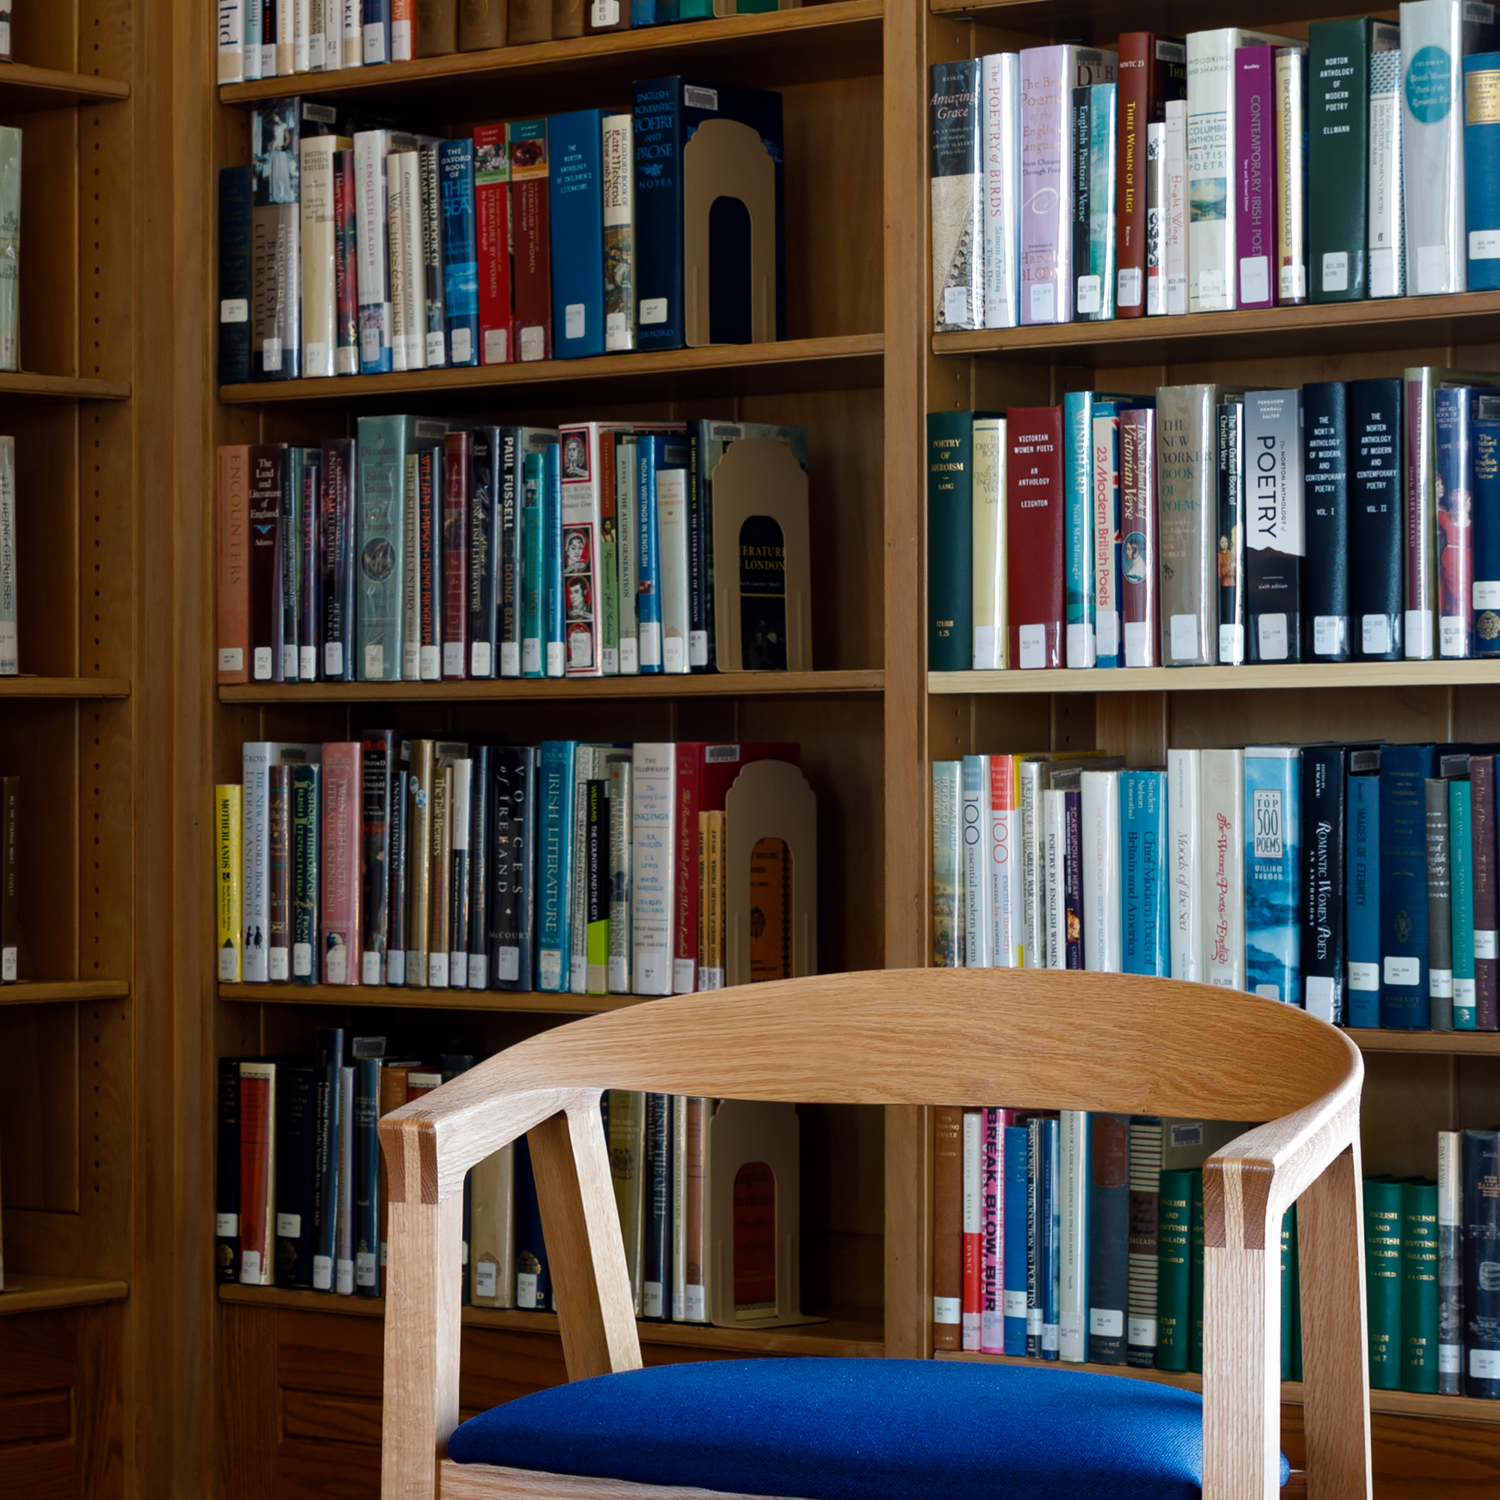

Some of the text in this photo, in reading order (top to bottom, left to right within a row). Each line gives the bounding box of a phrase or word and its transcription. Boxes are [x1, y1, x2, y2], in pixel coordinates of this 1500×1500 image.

[1325, 56, 1348, 66] NORTON
[1320, 68, 1354, 78] ANTHOLOGY
[1333, 80, 1340, 88] OF
[637, 91, 669, 102] ENGLISH
[930, 89, 976, 107] Amazing
[1326, 91, 1348, 100] MODERN
[635, 102, 674, 114] ROMANTIC
[1326, 103, 1348, 112] POETRY
[937, 107, 968, 119] Grace
[1126, 101, 1135, 132] THREE
[635, 116, 674, 131] POETRY
[1324, 125, 1350, 134] ELLMANN
[637, 145, 673, 160] PROSE
[442, 154, 471, 164] OXFORD
[445, 163, 466, 171] BOOK
[638, 178, 672, 189] NOYES
[1126, 176, 1132, 185] OF
[442, 181, 469, 196] THE
[443, 197, 471, 217] SEA
[638, 329, 674, 339] OXFORD
[933, 439, 961, 448] POETRY
[1361, 435, 1391, 444] ANTHOLOGY
[1014, 446, 1033, 454] WOMEN
[1371, 447, 1392, 455] MODERN
[941, 451, 950, 459] OF
[258, 459, 272, 467] The
[1371, 458, 1381, 466] AND
[932, 463, 964, 472] HEROISM
[256, 469, 274, 478] Land
[1357, 470, 1396, 478] CONTEMPORARY
[504, 438, 514, 530] PAUL FUSSELL
[1018, 478, 1050, 486] ANTHOLOGY
[1257, 435, 1277, 538] POETRY
[1366, 482, 1386, 490] POETRY
[249, 489, 281, 498] Literature
[261, 499, 269, 507] of
[251, 509, 279, 518] England
[1366, 505, 1378, 513] VOL.
[1096, 446, 1108, 606] 23 Modern British Poets
[1257, 799, 1278, 808] TOP
[964, 797, 980, 845] 100
[1257, 809, 1278, 835] 500
[221, 799, 230, 870] MOTHERLANDS
[1257, 837, 1280, 853] POEMS
[969, 847, 977, 887] essential
